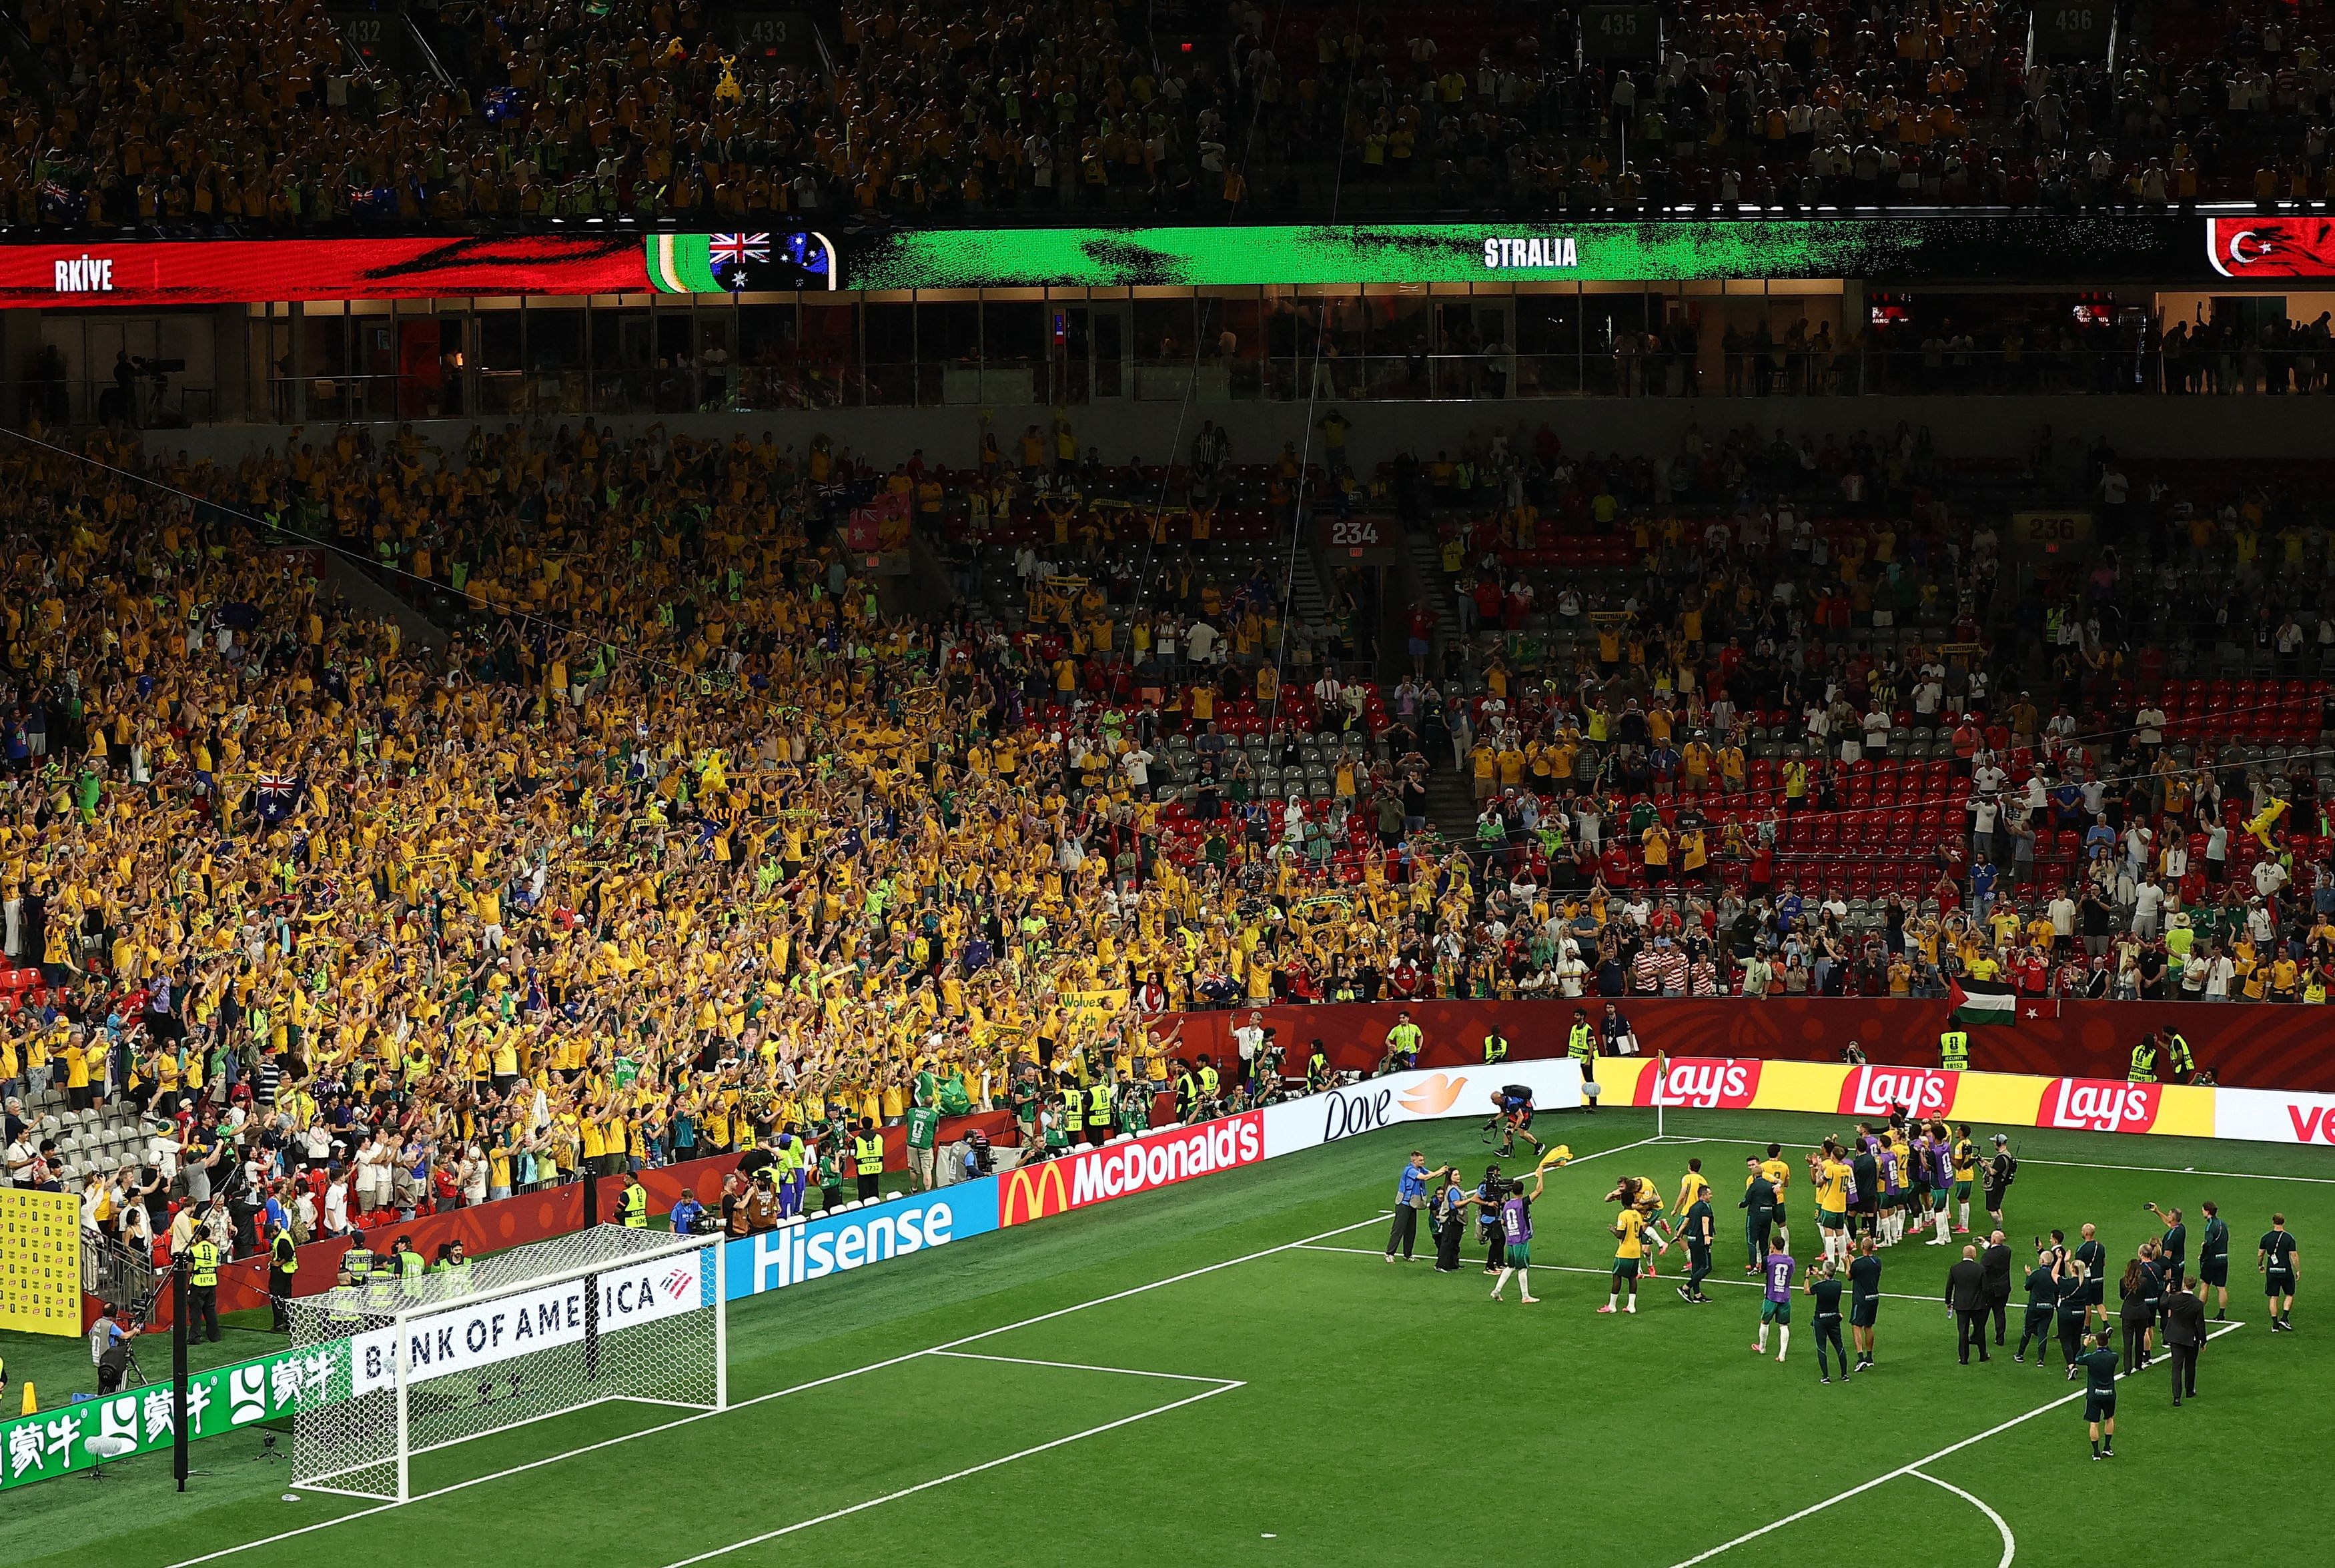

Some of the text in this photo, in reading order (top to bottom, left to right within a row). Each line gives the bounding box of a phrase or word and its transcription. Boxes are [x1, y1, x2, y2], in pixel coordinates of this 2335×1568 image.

[348, 20, 380, 41] 432
[751, 21, 787, 42] 433
[1600, 14, 1637, 35] 435
[2055, 9, 2092, 31] 436
[1484, 237, 1578, 267] STRALIA
[1332, 522, 1379, 544] 234
[2029, 518, 2074, 540] 236
[1084, 1012, 1097, 1026] th
[1650, 1058, 1747, 1108] Lay's
[1853, 1065, 1945, 1118] Lay's
[915, 1108, 931, 1116] PHOTO
[1324, 1088, 1391, 1142] Dove
[2053, 1078, 2148, 1132] Lay's
[1071, 1118, 1260, 1206] McDonald's
[1840, 1175, 1849, 1193] 19
[754, 1202, 953, 1294] Hisense
[466, 1313, 505, 1353] OF
[516, 1277, 655, 1342] AMEICA
[9, 1415, 81, 1479] 蒙牛
